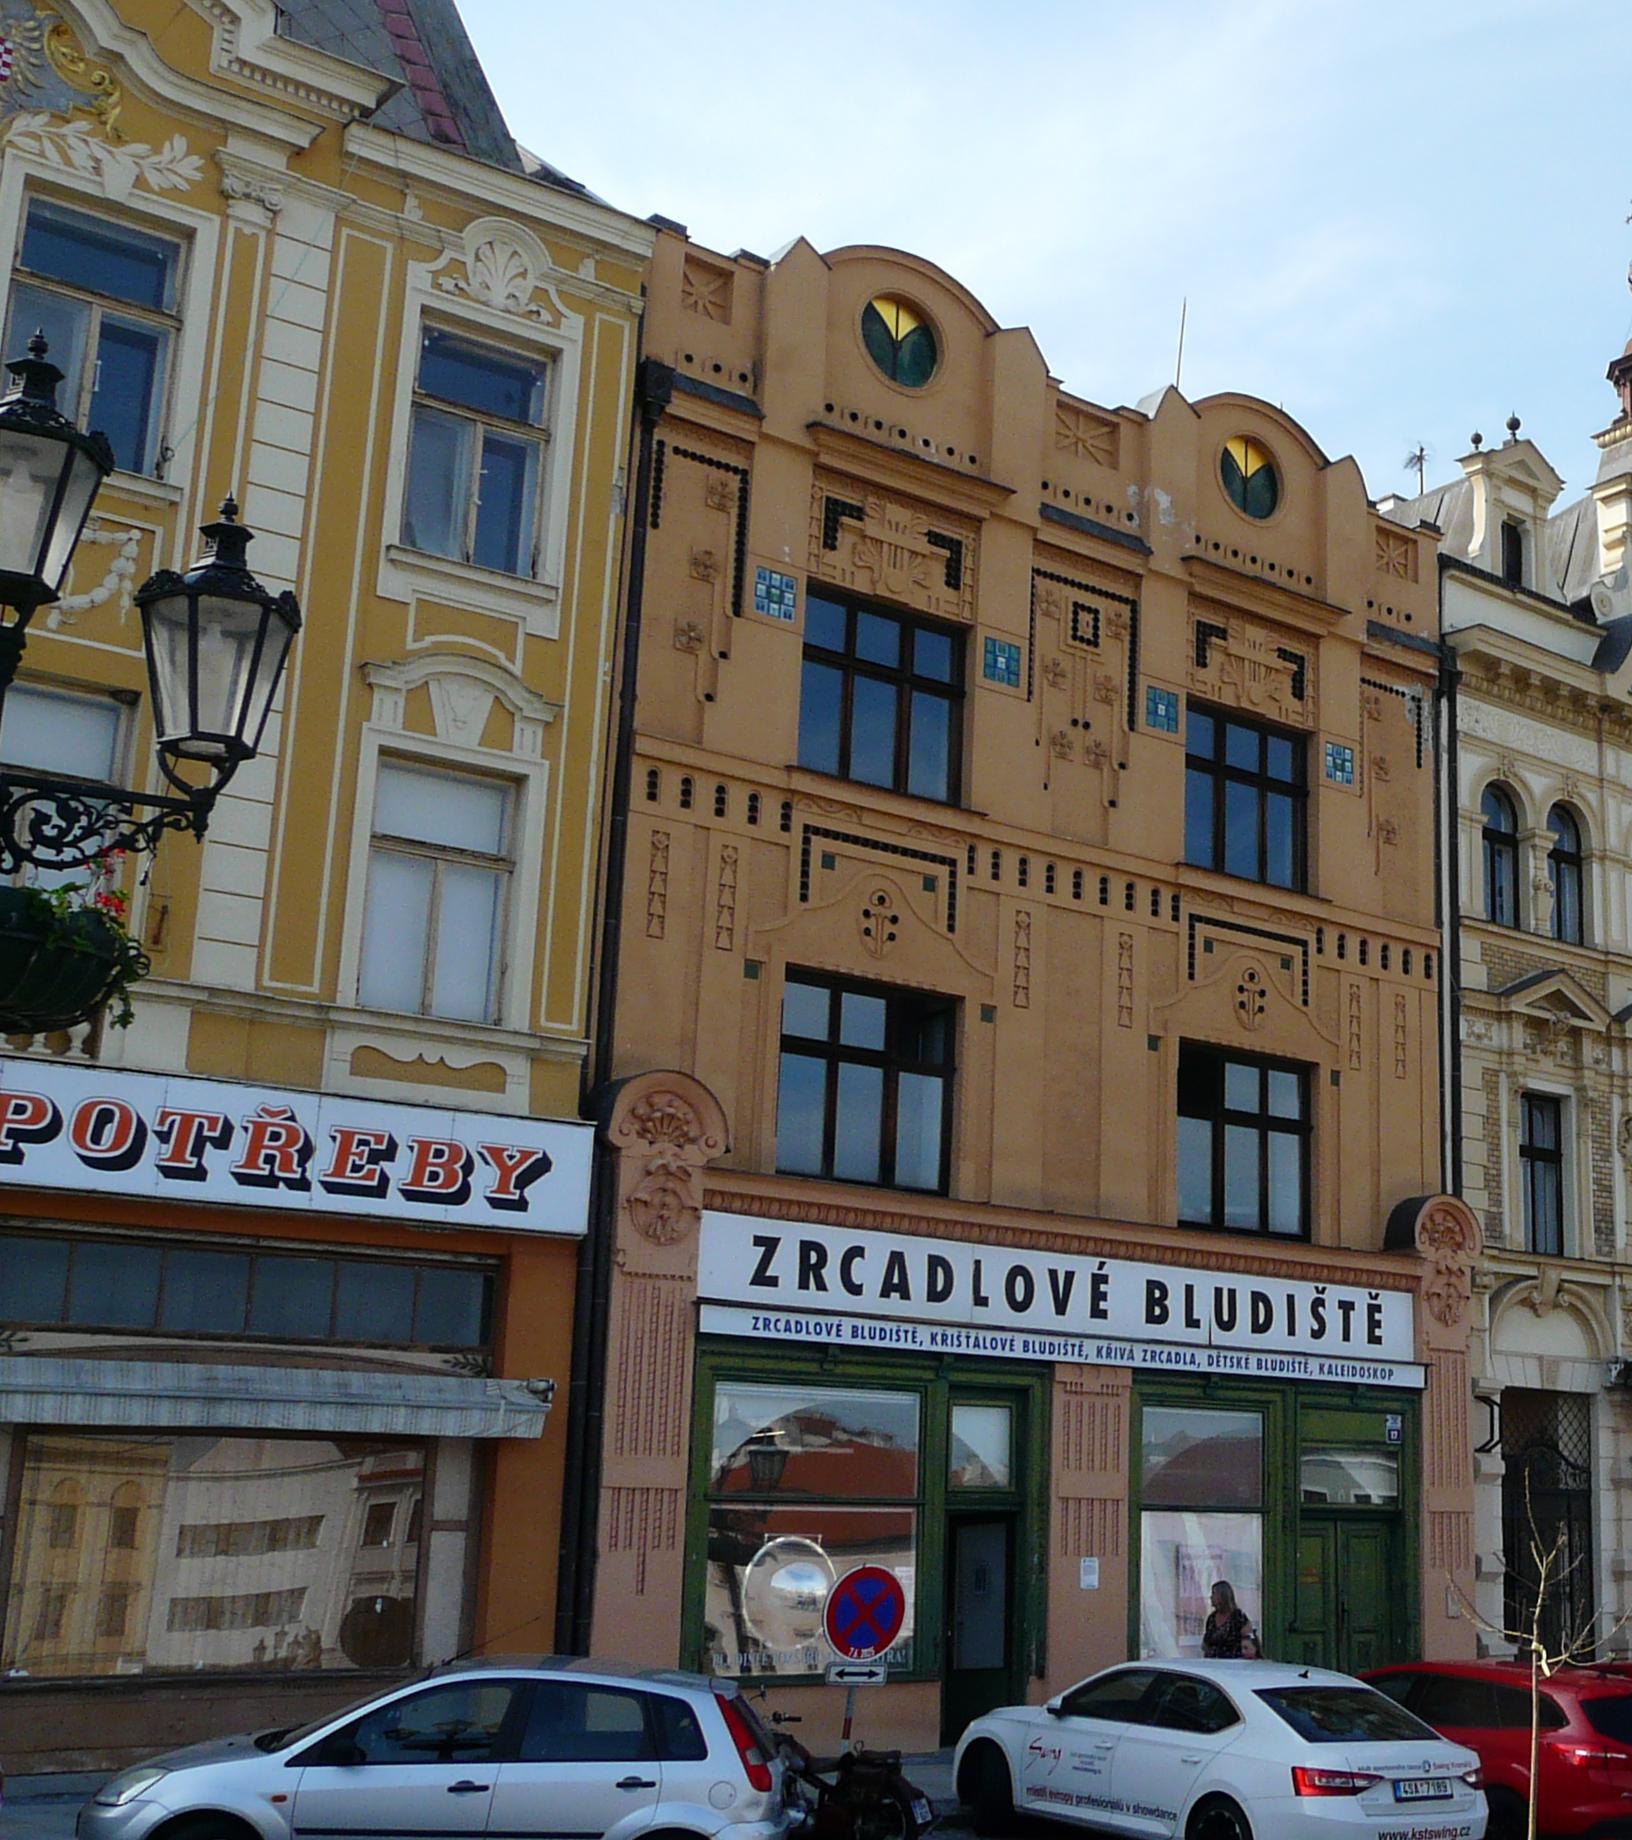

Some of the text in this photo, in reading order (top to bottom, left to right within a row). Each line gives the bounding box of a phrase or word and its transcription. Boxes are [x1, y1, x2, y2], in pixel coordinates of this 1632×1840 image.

[0, 1090, 553, 1212] POTŘEBY
[748, 1234, 1384, 1347] ZRCADLOVÉ BLUDIŠTĚ
[751, 1315, 1395, 1381] ZRCADLOVÉ BLUDIŠTĚ, KŘIŠŤÁLOVÉ BLUDIŠTĚ, KŘIVÁ ZRCADLA, DĚTSKÉ BLUDIŠTĚ, KALEIDOSKOP
[1132, 1802, 1178, 1822] showdance
[1378, 1826, 1471, 1840] www.kstswing.cz
